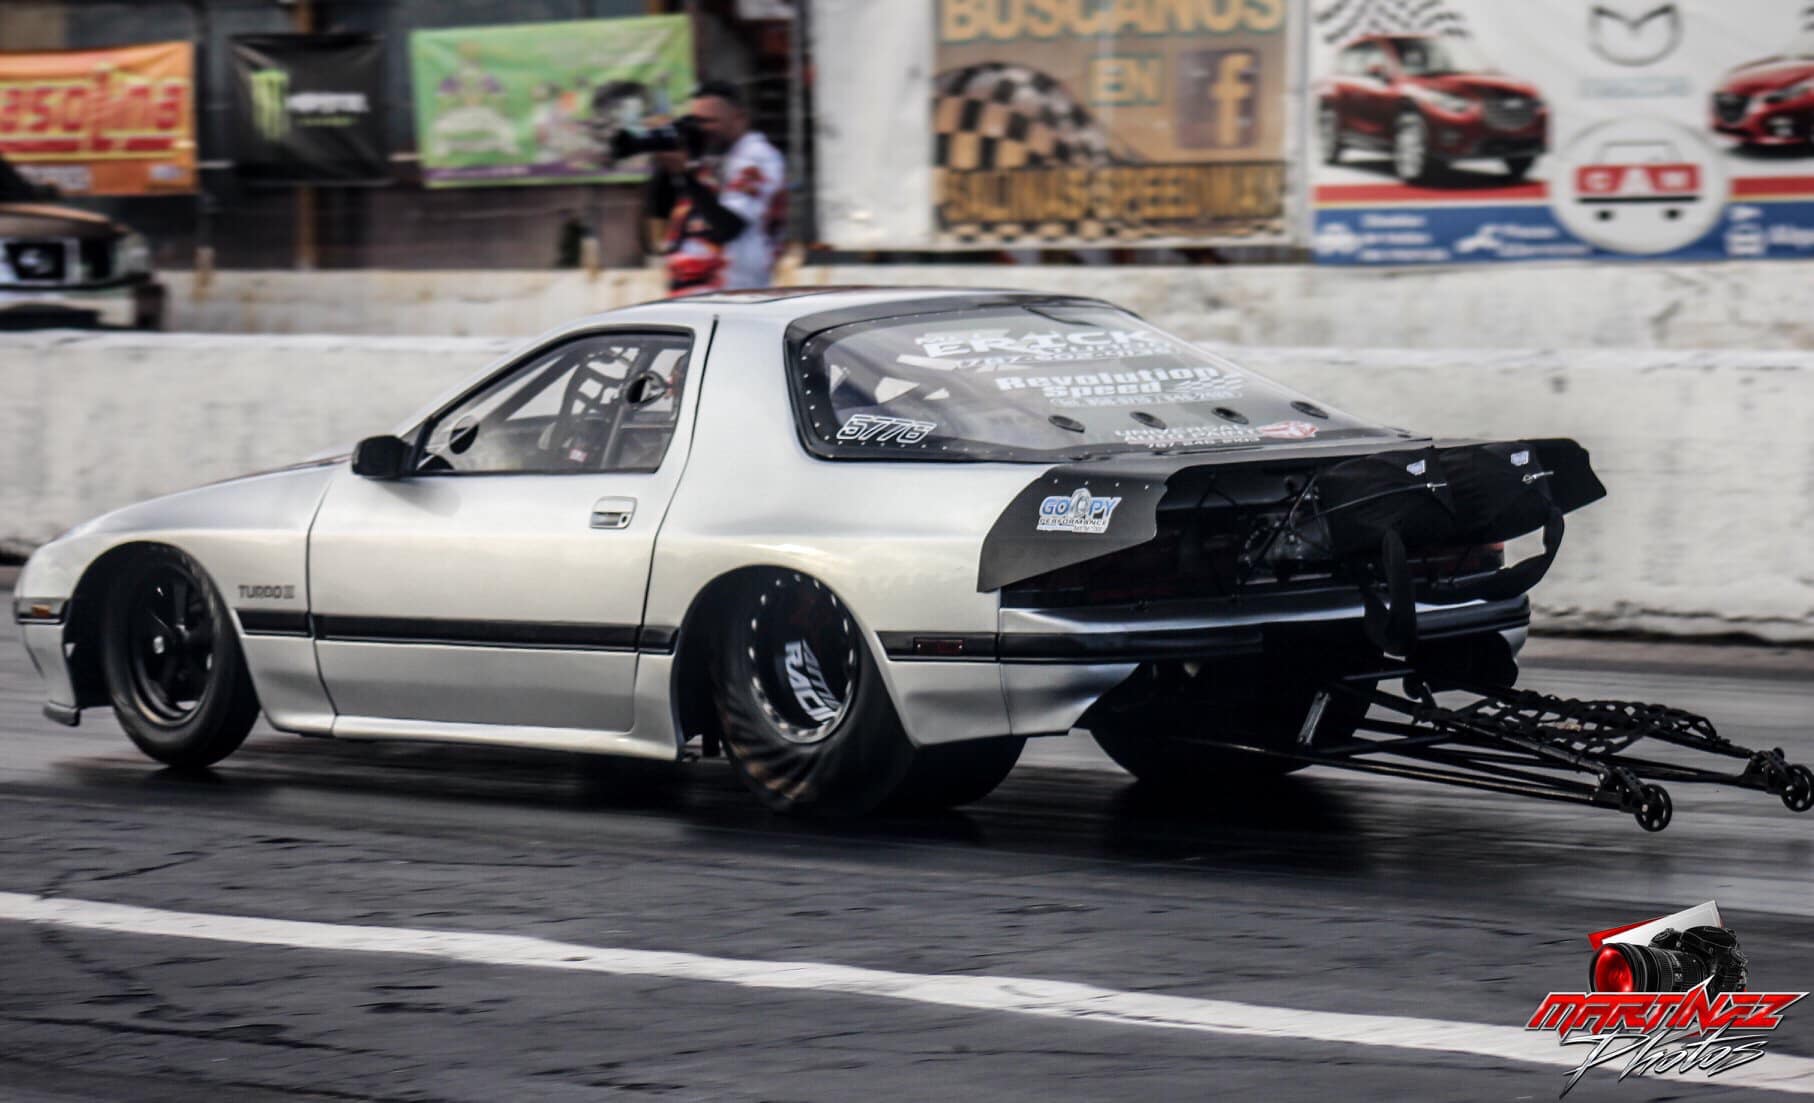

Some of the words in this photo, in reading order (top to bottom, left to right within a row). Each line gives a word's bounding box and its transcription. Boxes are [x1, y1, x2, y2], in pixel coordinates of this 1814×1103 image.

[1088, 53, 1164, 106] EN
[995, 367, 1219, 391] Revolution
[1043, 381, 1162, 399] Speed
[836, 414, 937, 444] 5776
[238, 585, 282, 599] TURBO
